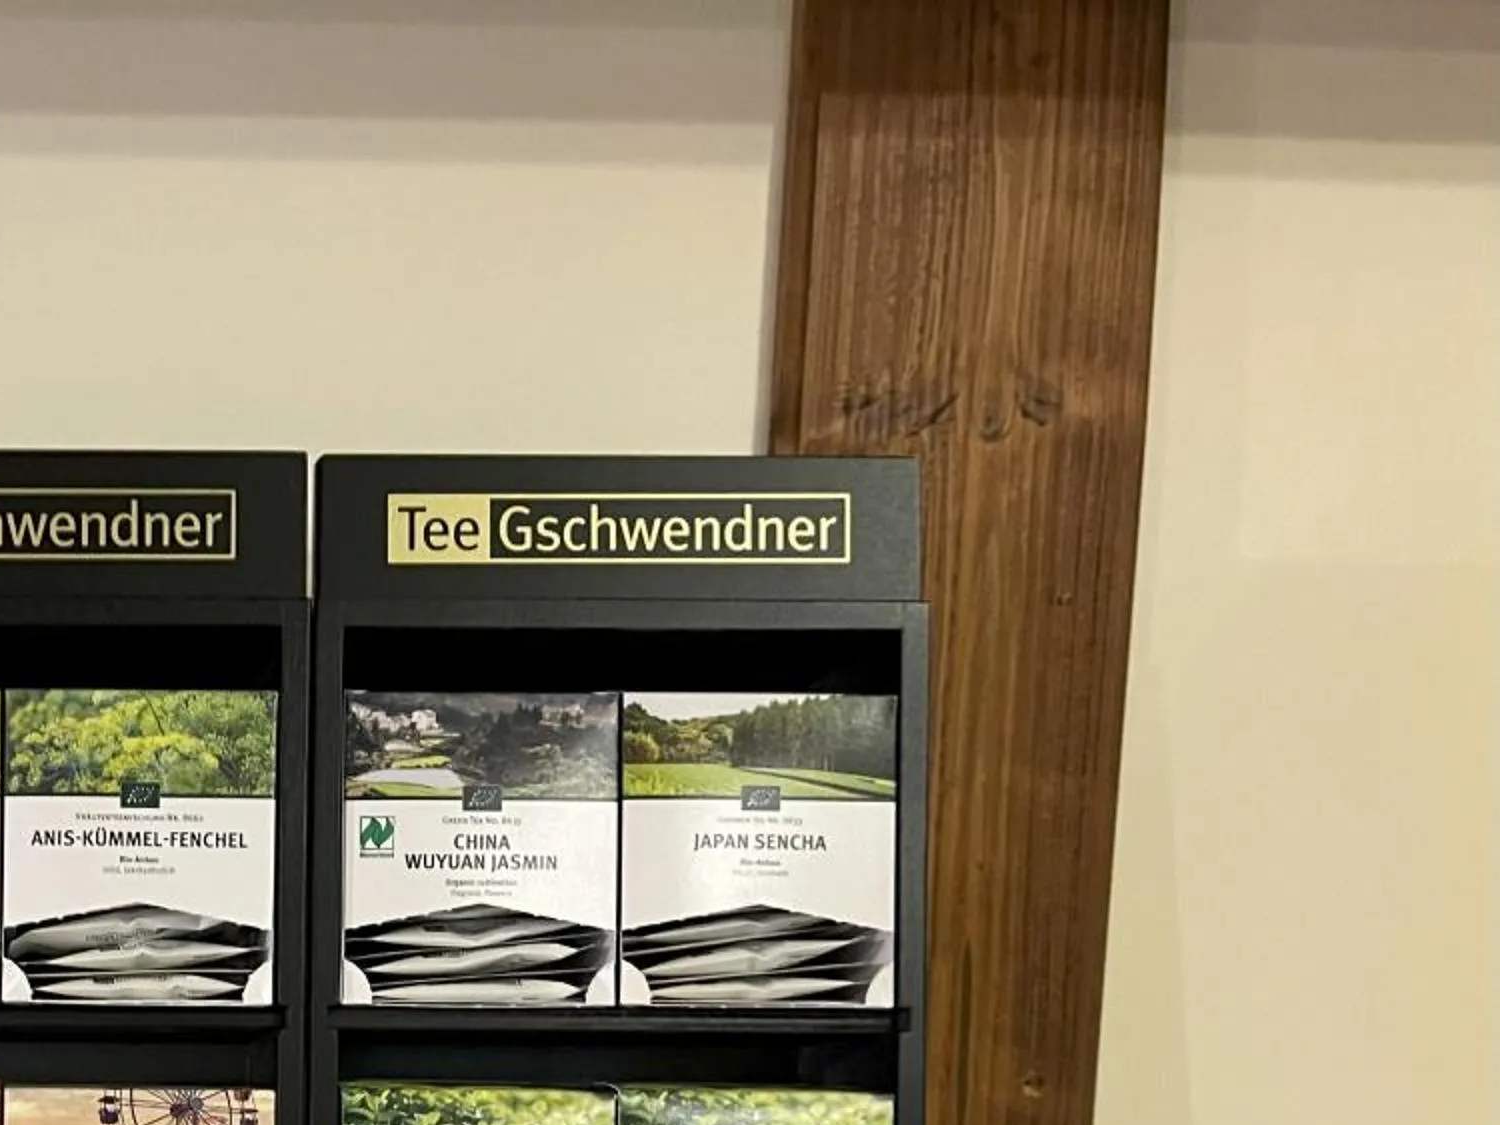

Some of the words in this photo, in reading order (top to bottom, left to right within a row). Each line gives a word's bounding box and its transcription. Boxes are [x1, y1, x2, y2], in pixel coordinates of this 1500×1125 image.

[398, 505, 479, 551] Tee
[499, 503, 837, 552] Gschwendner
[31, 827, 248, 848] ANIS-KÜMMEL-FENCHEL
[453, 834, 511, 850] CHINA
[693, 833, 749, 851] JAPAN
[754, 833, 827, 851] SENCHA
[405, 853, 486, 870] WUYUAN
[491, 854, 557, 872] JASMIN
